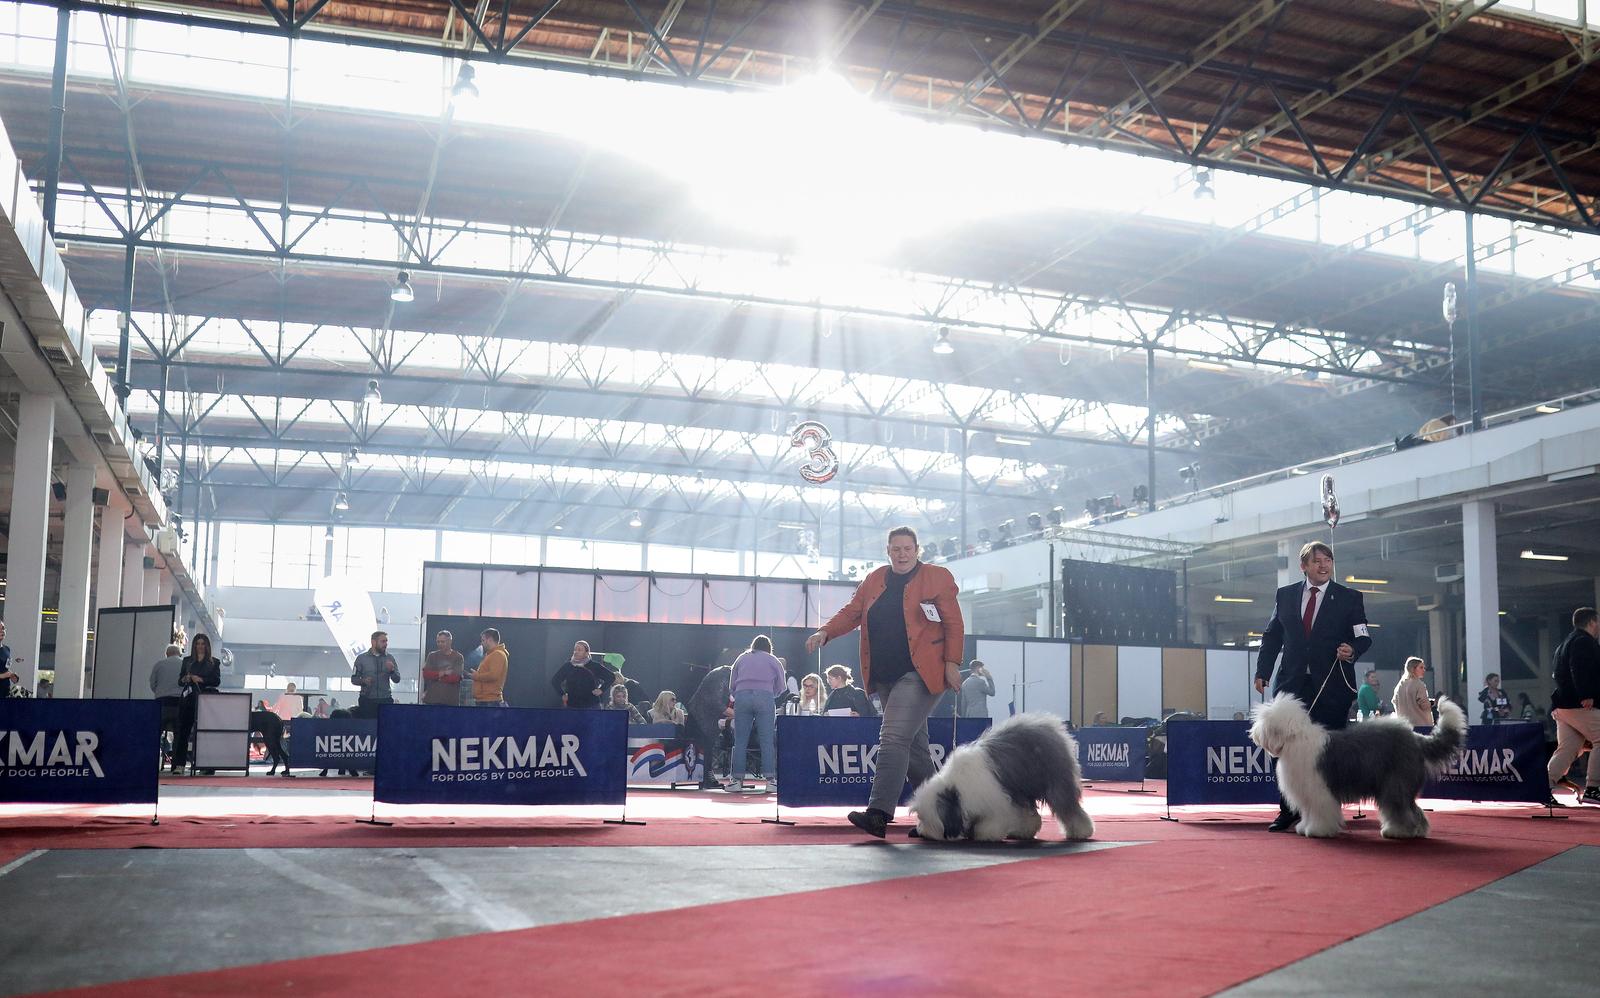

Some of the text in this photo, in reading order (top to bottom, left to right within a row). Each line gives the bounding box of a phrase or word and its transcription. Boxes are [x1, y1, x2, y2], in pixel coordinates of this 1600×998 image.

[432, 734, 588, 777] NEKMAR
[1087, 743, 1130, 767] NEKMAR
[1440, 748, 1523, 782] EKMAR
[8, 769, 37, 777] DOG
[41, 768, 90, 777] PEOPLE
[431, 769, 575, 782] FOR DOGS BY DOG PEOPLE
[1207, 775, 1225, 783] FOR
[1226, 775, 1250, 783] DOGS
[1252, 775, 1263, 783] BY
[819, 776, 839, 784] FOR
[841, 776, 867, 784] DOGS
